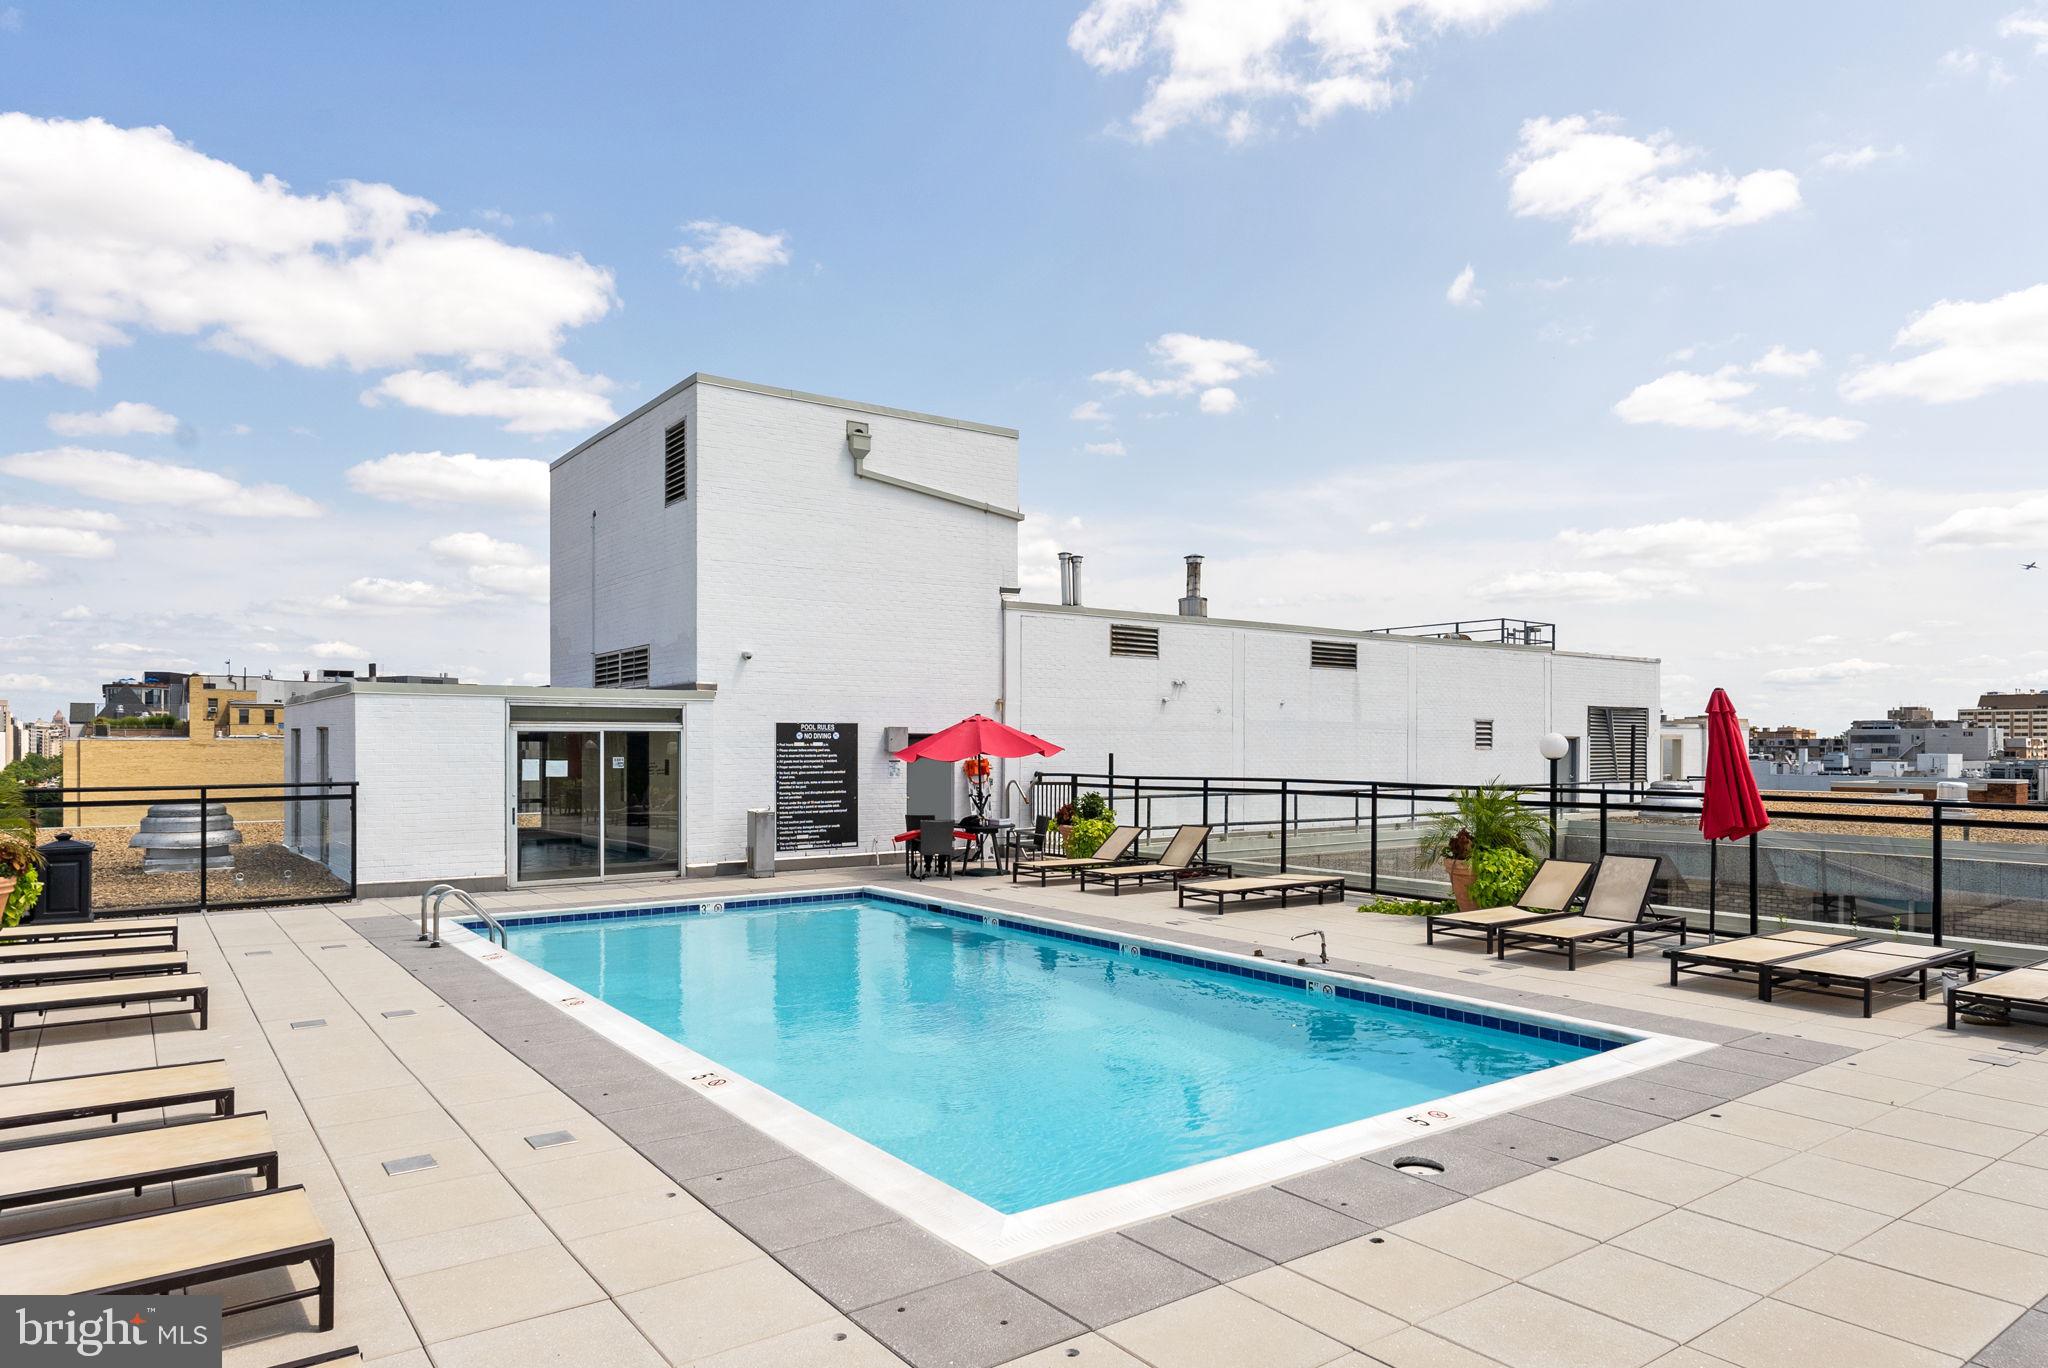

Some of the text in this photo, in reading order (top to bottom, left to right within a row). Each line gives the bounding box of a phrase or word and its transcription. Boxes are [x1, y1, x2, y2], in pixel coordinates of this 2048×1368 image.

[800, 723, 835, 731] POOL RULES
[813, 732, 832, 740] DIVING
[1406, 1116, 1430, 1127] 5
